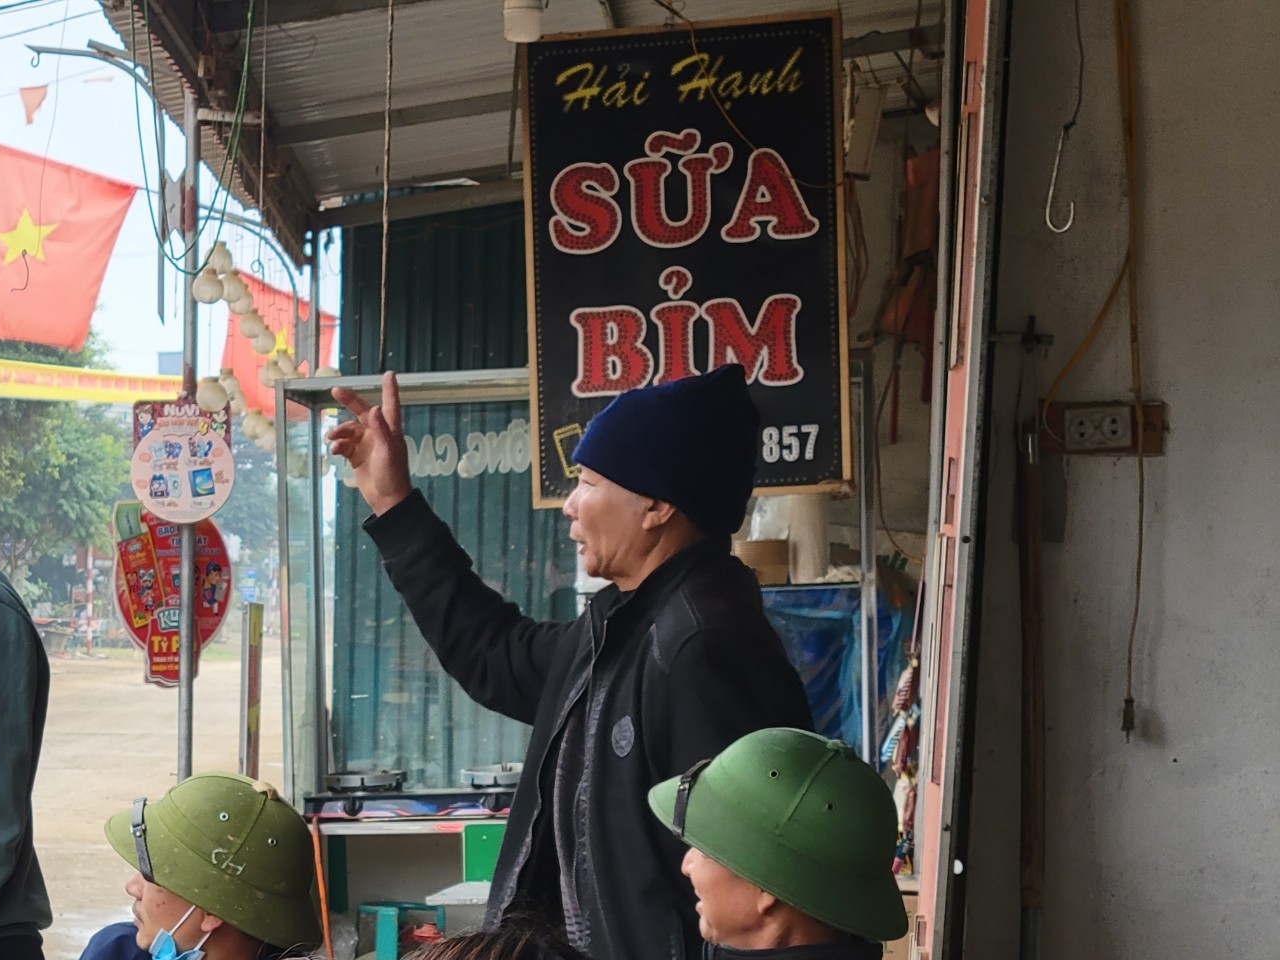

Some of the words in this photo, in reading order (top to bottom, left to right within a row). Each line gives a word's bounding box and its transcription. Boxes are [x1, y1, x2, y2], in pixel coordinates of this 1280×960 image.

[555, 61, 651, 113] Hải
[671, 47, 804, 111] Hạnh
[549, 128, 818, 255] SỮA
[569, 265, 805, 398] BỈM
[761, 424, 820, 464] 857
